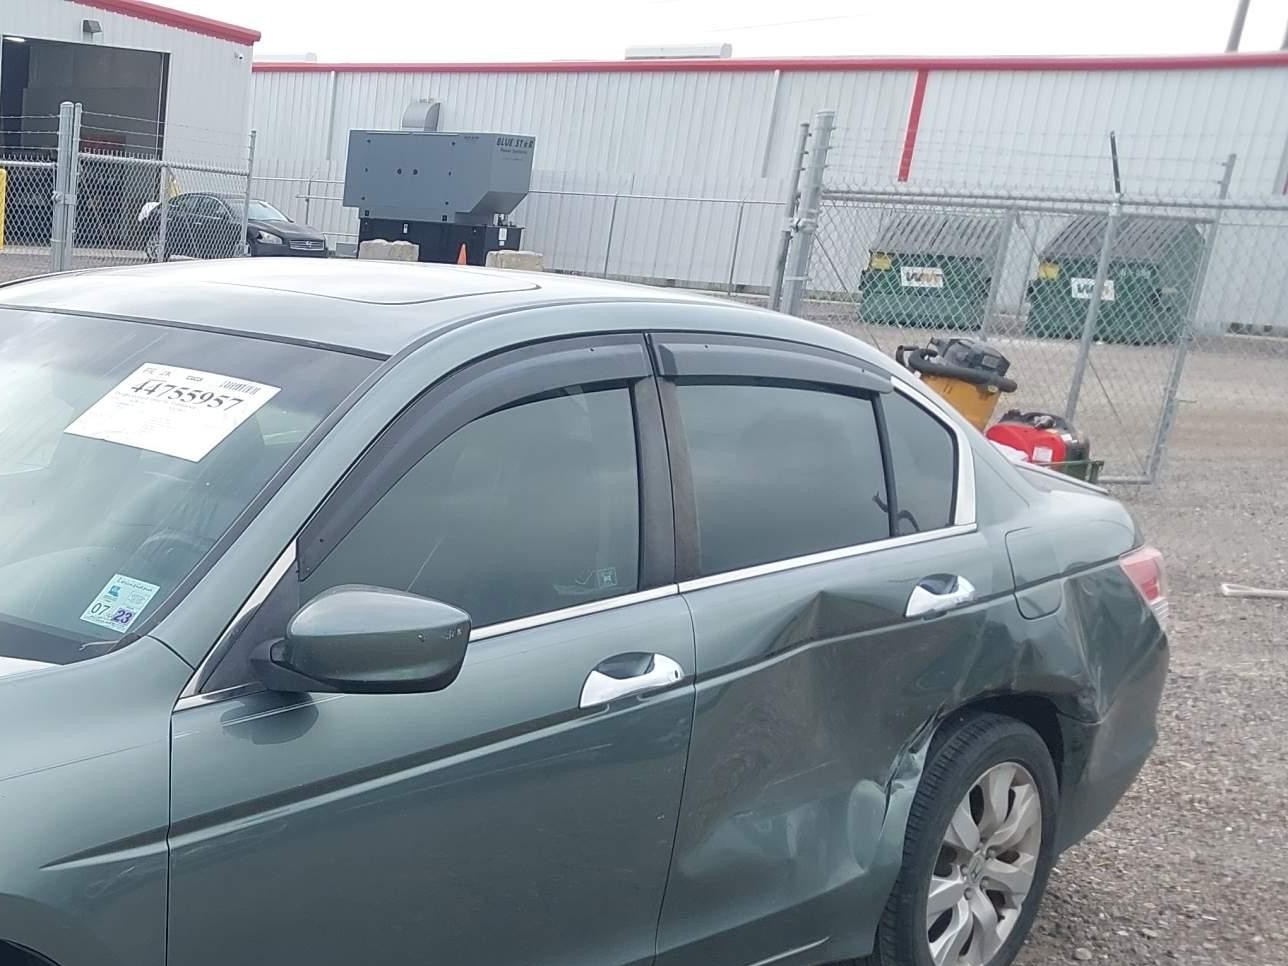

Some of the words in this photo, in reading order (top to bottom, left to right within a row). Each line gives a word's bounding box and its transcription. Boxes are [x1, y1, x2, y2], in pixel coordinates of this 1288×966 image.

[496, 137, 513, 147] BLUE
[131, 379, 245, 412] 44755957
[91, 602, 110, 616] 07
[113, 609, 132, 623] 23
